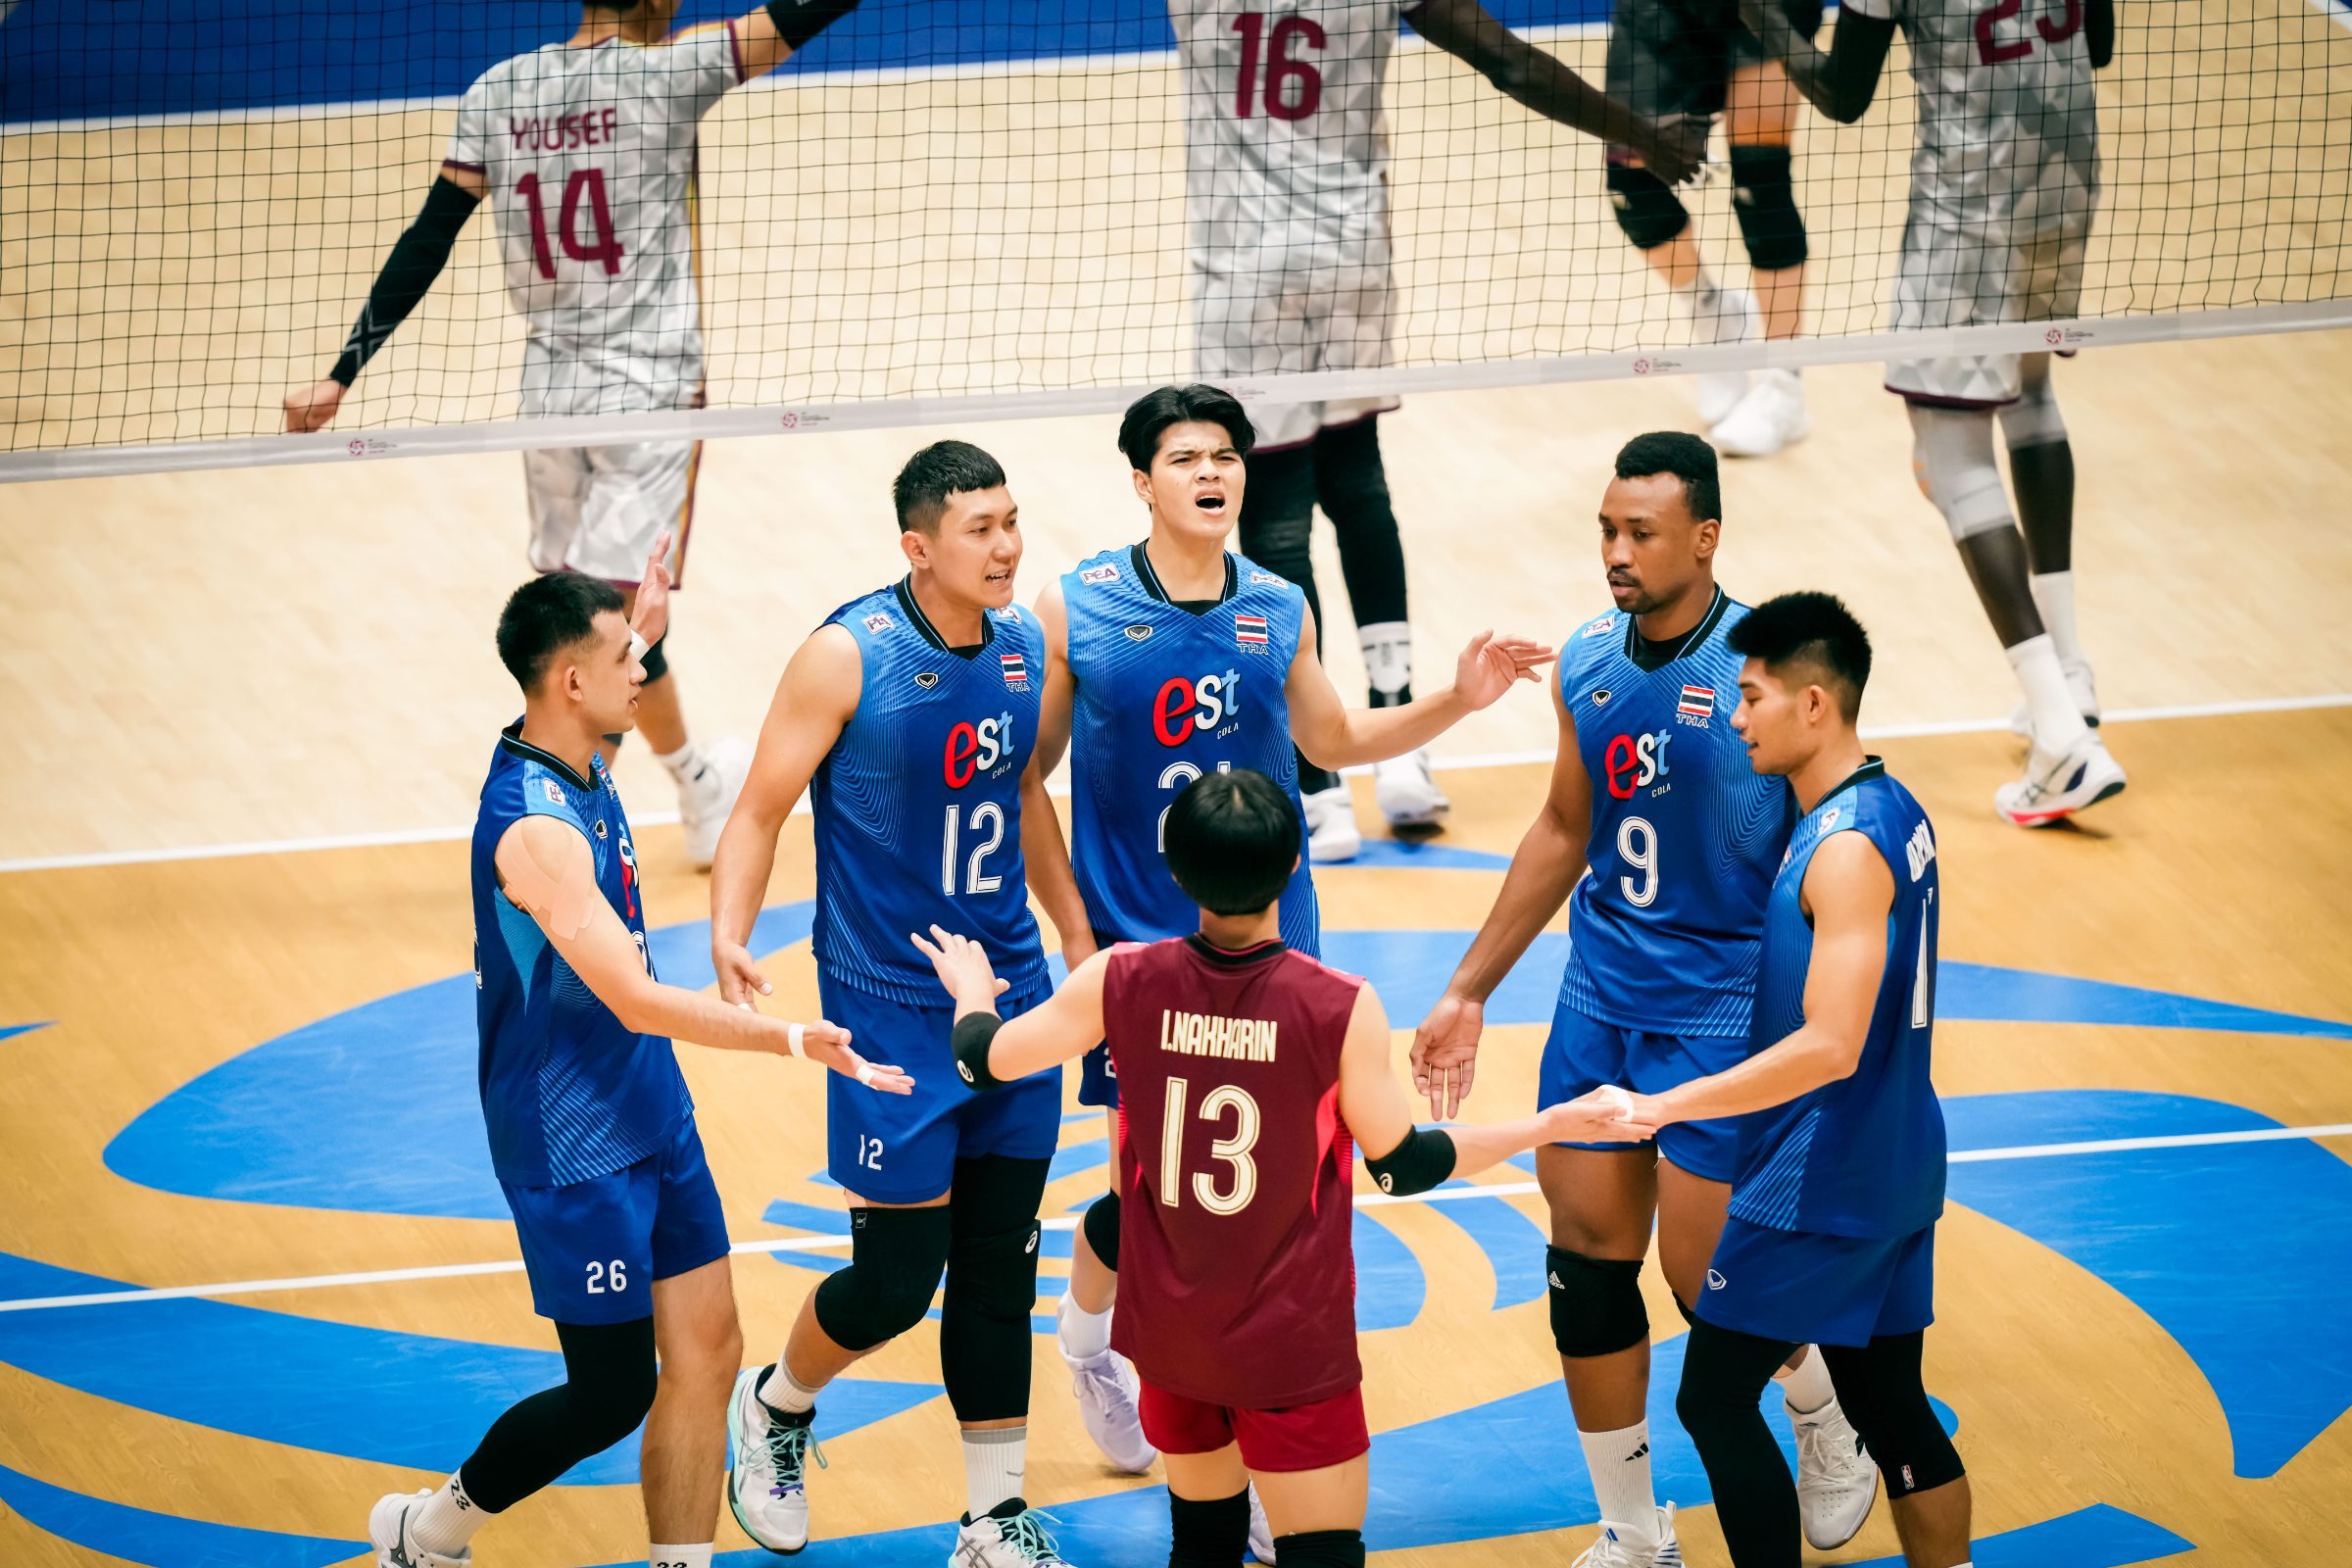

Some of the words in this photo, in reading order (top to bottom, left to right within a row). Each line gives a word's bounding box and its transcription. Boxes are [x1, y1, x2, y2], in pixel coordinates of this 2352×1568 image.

[1232, 12, 1327, 122] 16
[511, 109, 617, 152] YOUSEF
[516, 168, 624, 279] 14
[1082, 567, 1116, 581] PEA
[1237, 643, 1269, 656] THA
[1005, 682, 1030, 693] THA
[1153, 667, 1241, 748] est
[1217, 721, 1240, 740] COLA
[1676, 713, 1709, 729] THA
[944, 710, 1015, 790] est
[992, 761, 1012, 780] COLA
[1604, 728, 1672, 801] est
[1651, 782, 1672, 799] COLA
[942, 801, 1004, 897] 12
[1617, 815, 1659, 908] 9
[1160, 1008, 1278, 1063] I.NAKHARIN
[858, 1133, 884, 1171] 12
[1160, 1076, 1261, 1216] 13
[585, 1258, 627, 1295] 26
